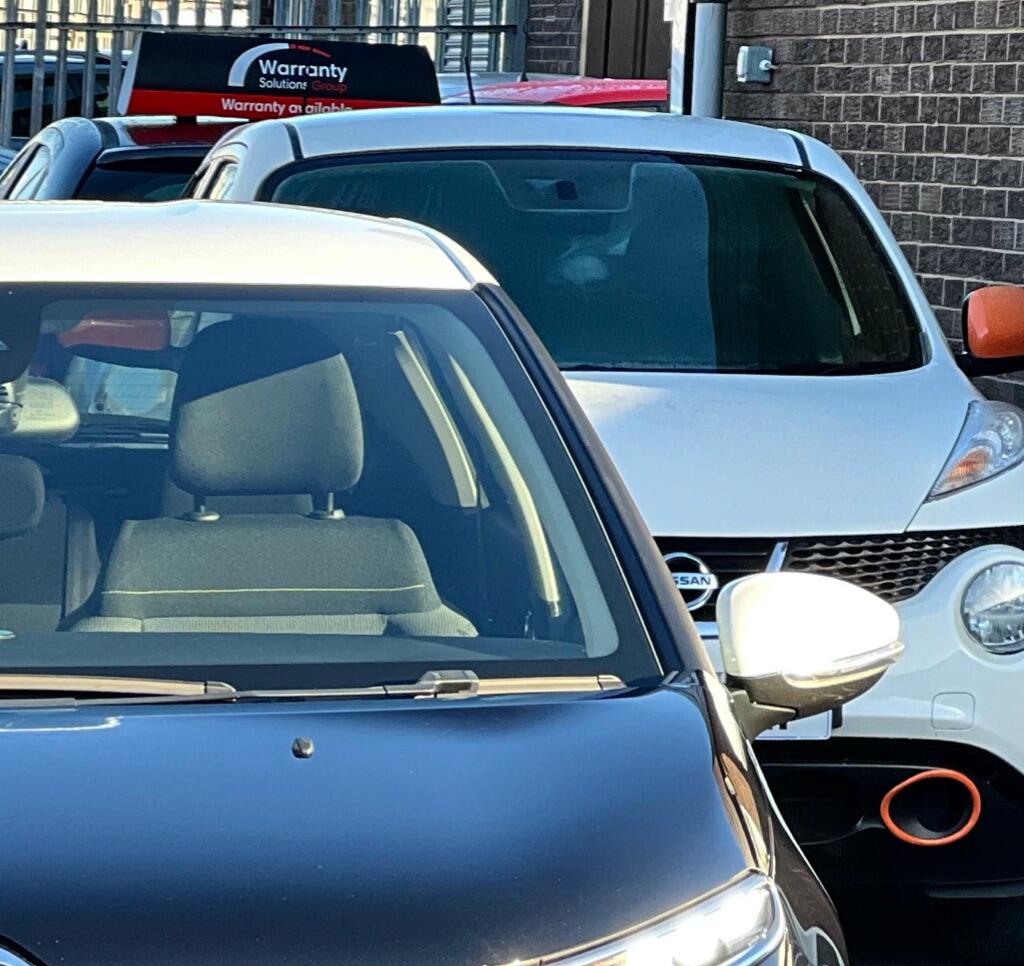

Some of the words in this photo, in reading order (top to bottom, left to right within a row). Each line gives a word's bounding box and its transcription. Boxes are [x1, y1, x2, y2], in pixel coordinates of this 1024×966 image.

[258, 59, 348, 83] Warranty
[258, 77, 307, 90] Solutions
[311, 80, 348, 94] Group
[220, 97, 286, 117] Warranty
